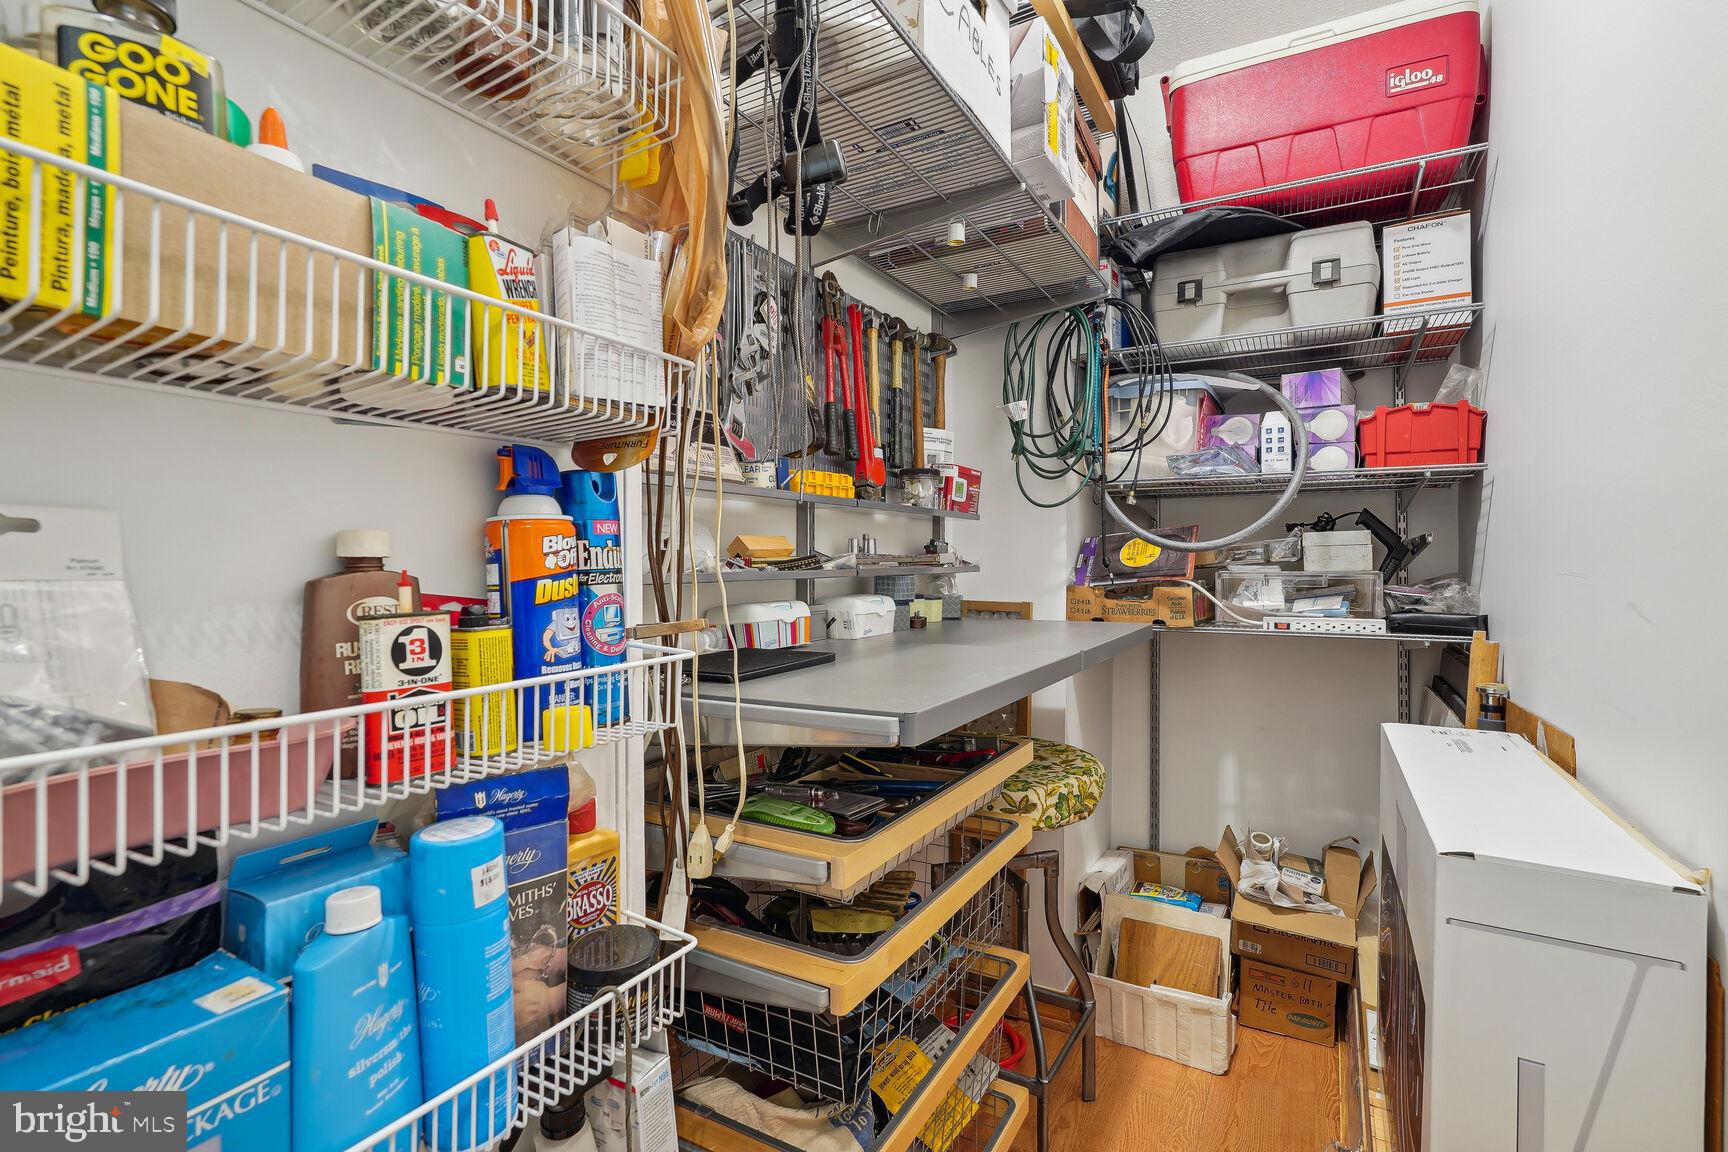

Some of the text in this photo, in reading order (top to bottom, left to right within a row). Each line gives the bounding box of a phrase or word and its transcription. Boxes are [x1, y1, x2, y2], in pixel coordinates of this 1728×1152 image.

[77, 31, 191, 86] GOO
[1390, 68, 1444, 88] igloo 48
[67, 58, 199, 120] GONE
[2, 81, 21, 138] métal
[49, 82, 74, 292] Pintura, madea, metal
[1407, 221, 1444, 232] CHAFON
[0, 197, 22, 280] Peinture,
[395, 230, 405, 269] eburring
[497, 248, 535, 284] Liquid
[501, 278, 539, 299] WRENCH
[411, 322, 423, 365] Ponçage
[599, 439, 649, 450] FURNITURE
[596, 523, 618, 534] NEW
[578, 573, 588, 582] for
[1101, 605, 1157, 617] STRAWBERRIES
[584, 619, 602, 650] Cleaning
[335, 641, 360, 658] RU
[408, 638, 427, 656] 3
[541, 662, 573, 675] Removes
[397, 675, 440, 687] 3-IN-ONE
[490, 787, 528, 804] Hagerty
[508, 804, 525, 812] trusted
[566, 884, 613, 922] BRASSO
[1252, 982, 1324, 1009] MASTER BATH
[1254, 997, 1278, 1015] Tile
[369, 1051, 405, 1089] polish
